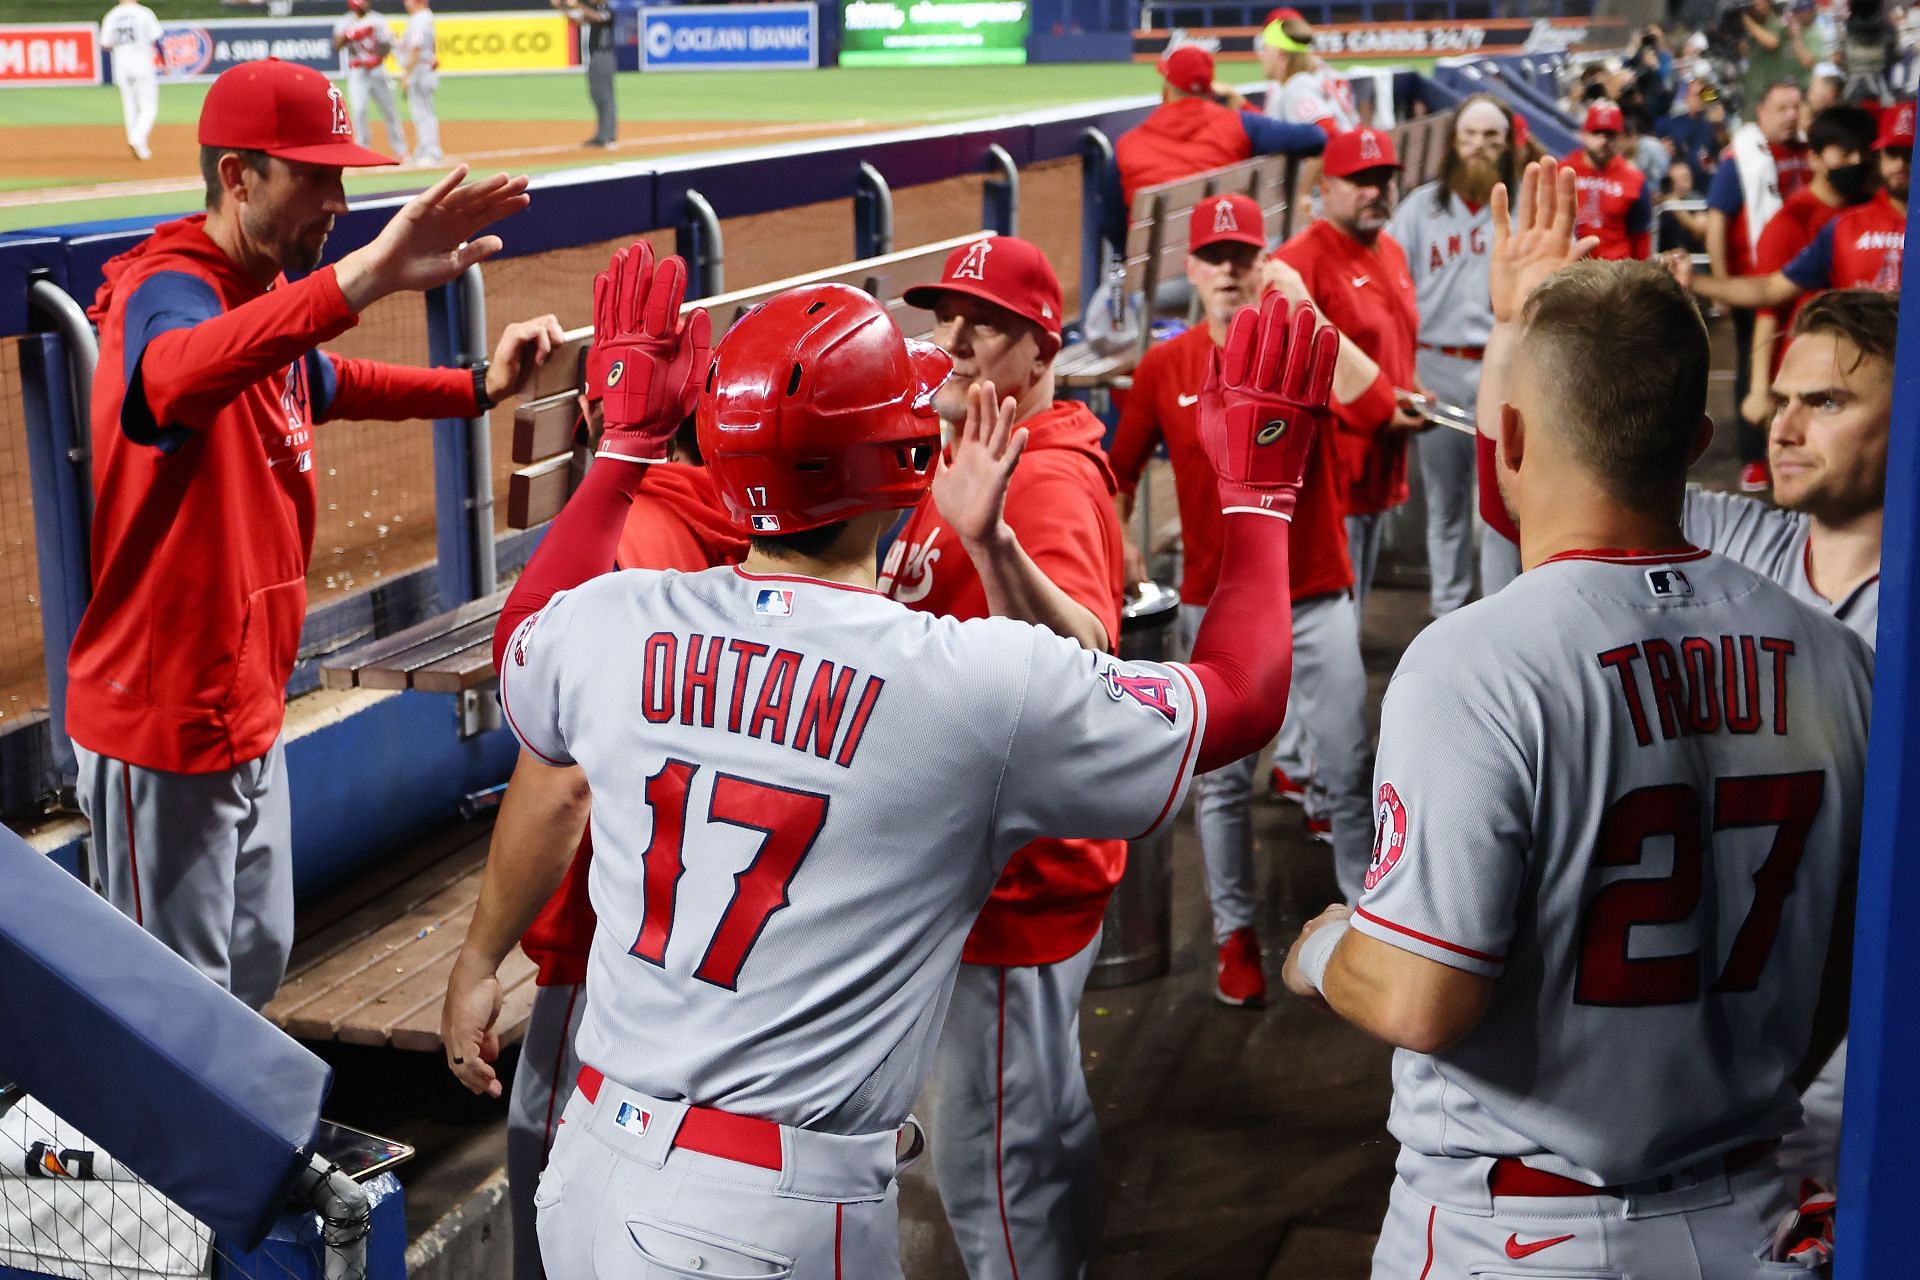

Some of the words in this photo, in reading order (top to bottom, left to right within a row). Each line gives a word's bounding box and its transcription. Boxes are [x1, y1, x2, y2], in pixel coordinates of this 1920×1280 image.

[214, 41, 231, 61] A
[231, 40, 270, 58] SUB
[271, 38, 333, 59] ABOVE
[673, 27, 747, 51] OCEAN
[749, 24, 809, 50] BANK
[1347, 29, 1429, 52] CARDS
[1430, 25, 1486, 51] 24/7
[746, 486, 768, 507] 17
[1260, 494, 1274, 509] 17
[641, 631, 886, 768] OHTANI
[1597, 634, 1795, 748] TROUT
[627, 757, 831, 992] 17
[1572, 769, 1826, 1008] 27
